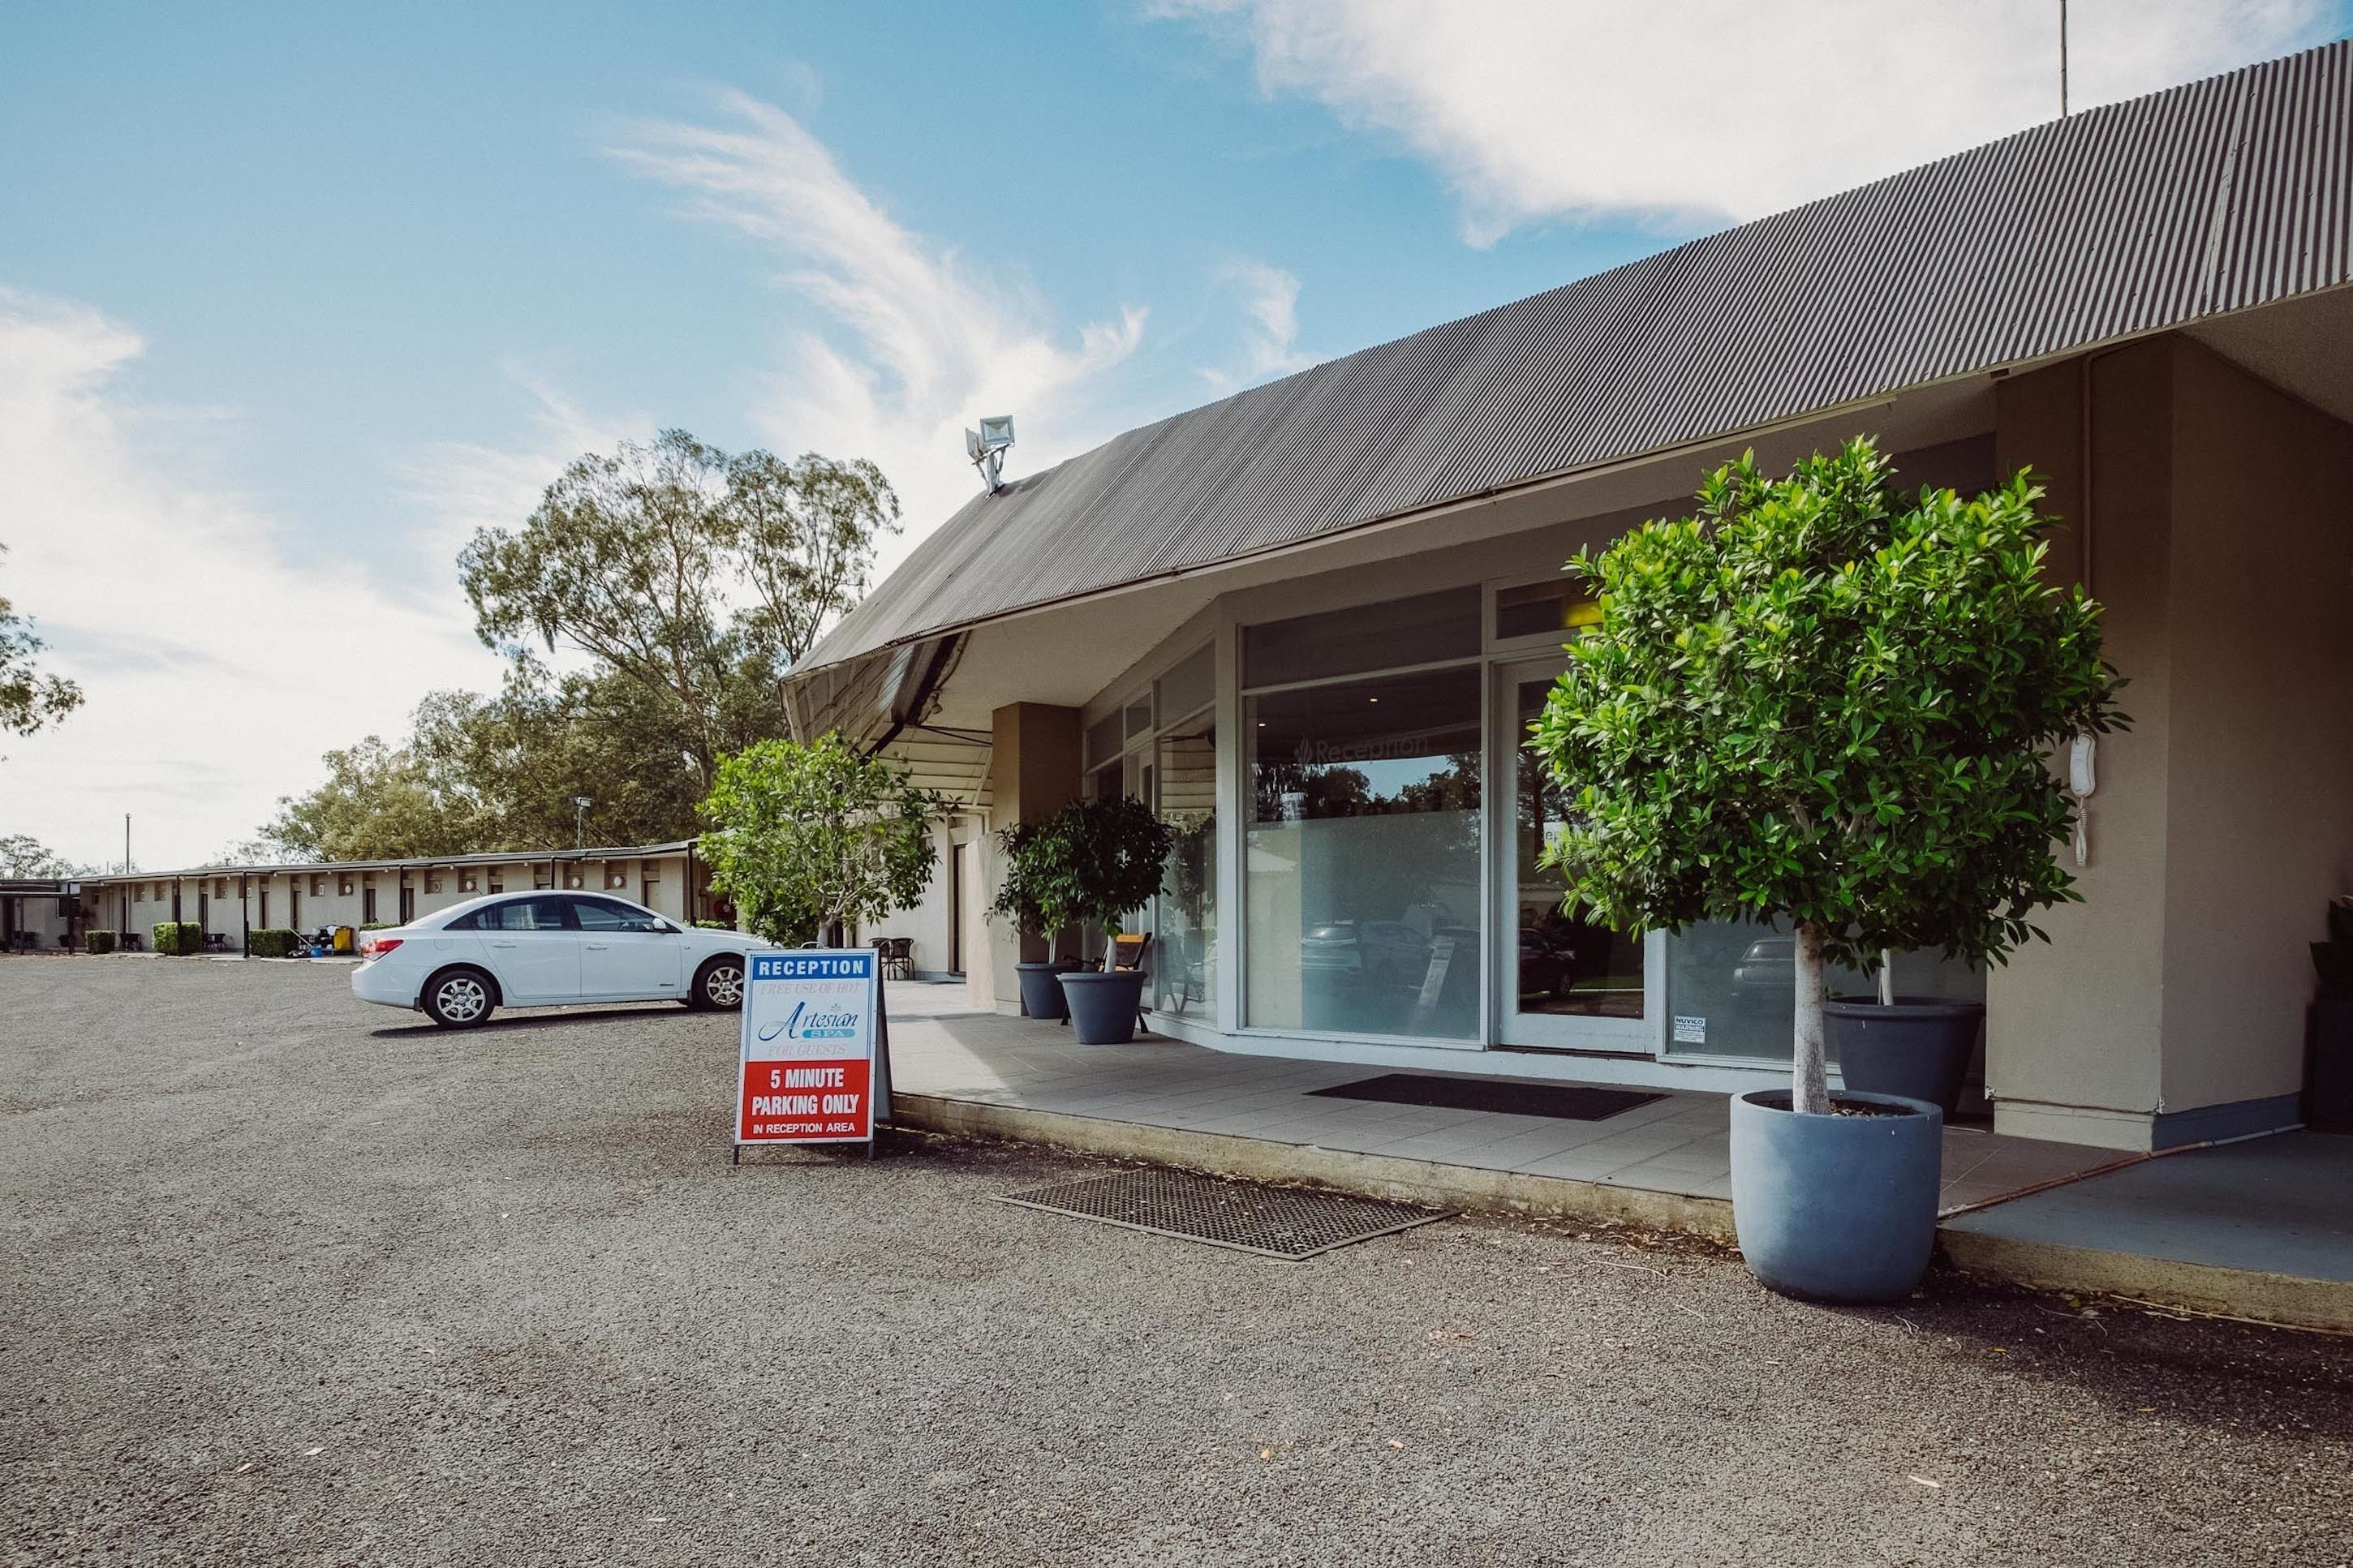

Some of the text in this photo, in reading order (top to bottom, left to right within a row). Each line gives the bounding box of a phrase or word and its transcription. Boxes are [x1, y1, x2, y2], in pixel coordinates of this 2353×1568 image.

[759, 960, 863, 976] RECEPTION
[760, 982, 861, 994] FREE USE OF HOT
[758, 1001, 858, 1042] Artesian
[811, 1029, 846, 1038] SPA
[768, 1043, 847, 1057] FOR GUESTS
[770, 1068, 844, 1089] 5 MINUTE
[751, 1093, 859, 1116] PARKING ONLY
[753, 1122, 855, 1134] IN RECEPTION AREA
